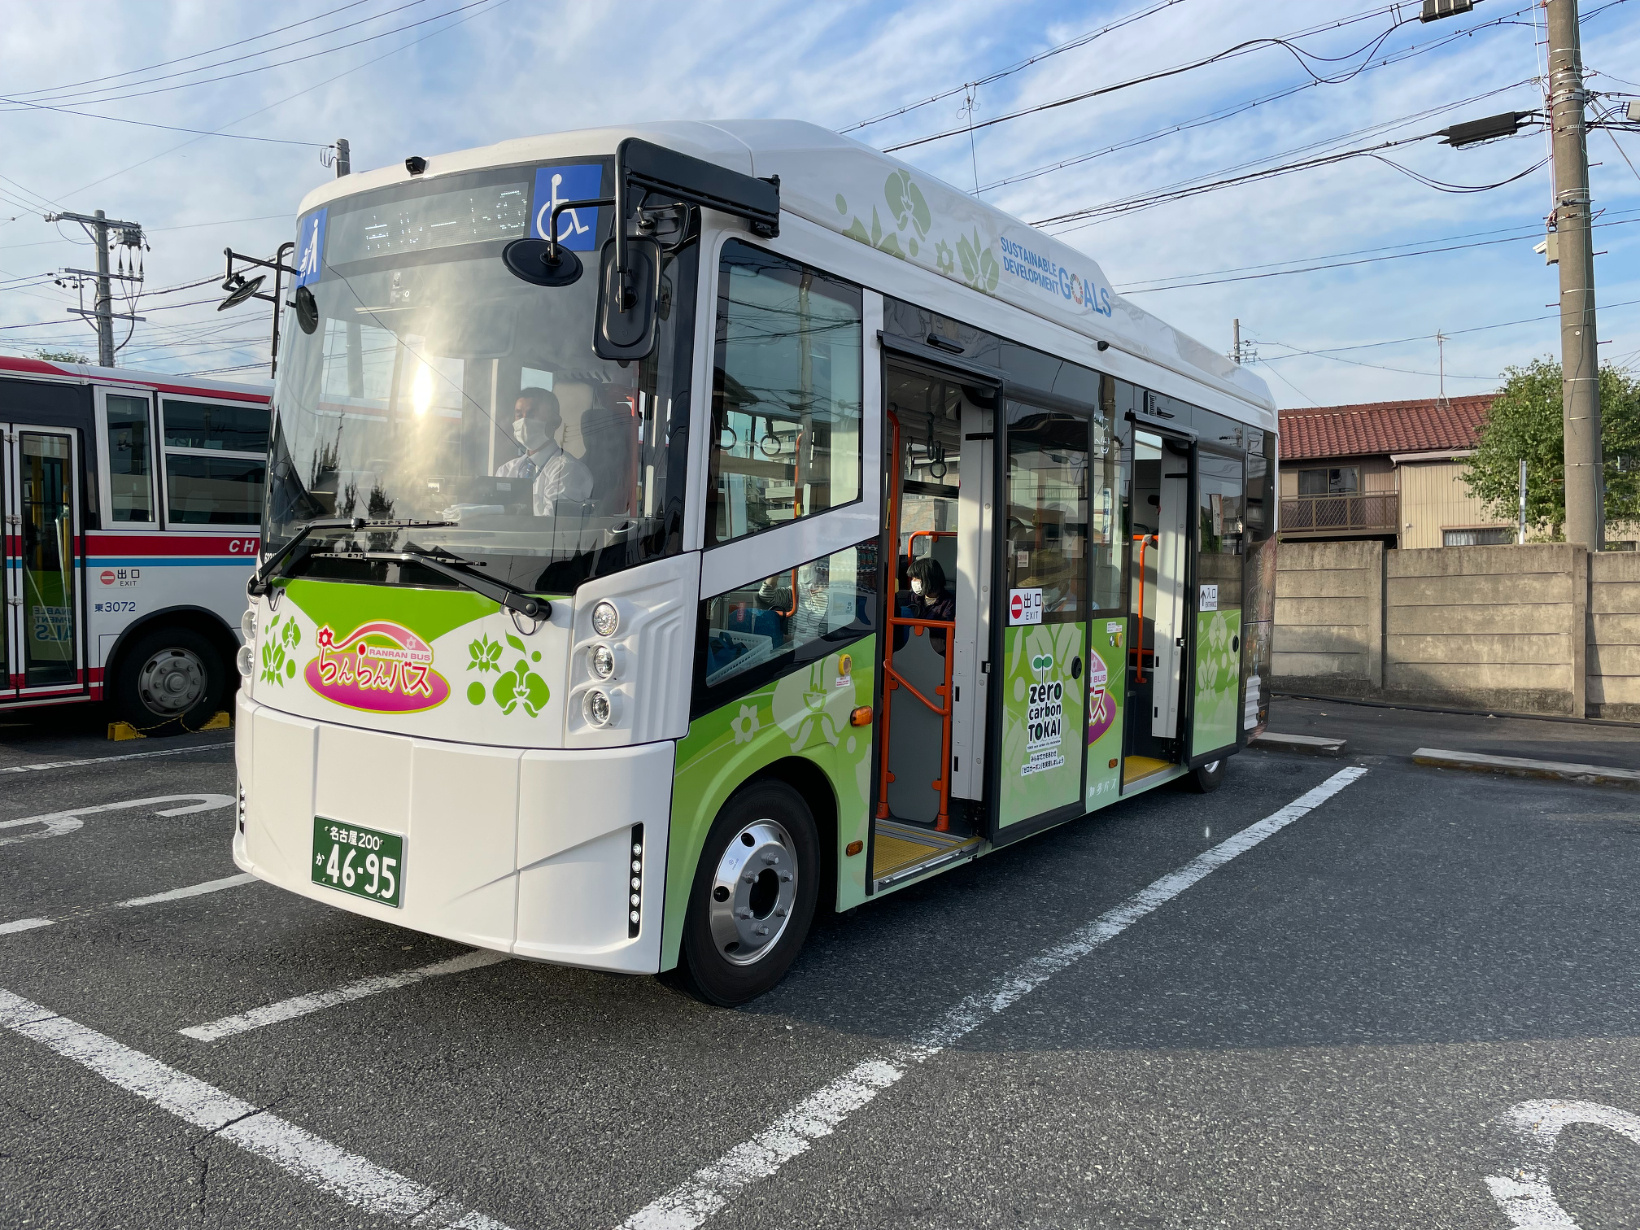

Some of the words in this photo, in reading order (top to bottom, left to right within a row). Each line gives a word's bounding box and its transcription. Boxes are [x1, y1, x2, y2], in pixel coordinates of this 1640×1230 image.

[1001, 237, 1057, 277] SUSTAINABLE
[1003, 256, 1059, 295] DEVELOPMENT
[1059, 267, 1111, 318] GOALS
[117, 569, 140, 580] 出口
[1024, 593, 1041, 608] 出口
[1206, 587, 1216, 599] 入口
[94, 601, 136, 612] 東3072
[1026, 611, 1038, 620] EXIT
[369, 648, 408, 659] RANRAN
[410, 652, 431, 661] BUS
[319, 643, 430, 694] らんらんバス
[1094, 674, 1106, 683] BUS
[1029, 683, 1062, 704] zero
[1029, 702, 1061, 720] carbon
[1028, 719, 1060, 741] TOKAI
[315, 852, 325, 866] か
[326, 844, 397, 899] 46-95
